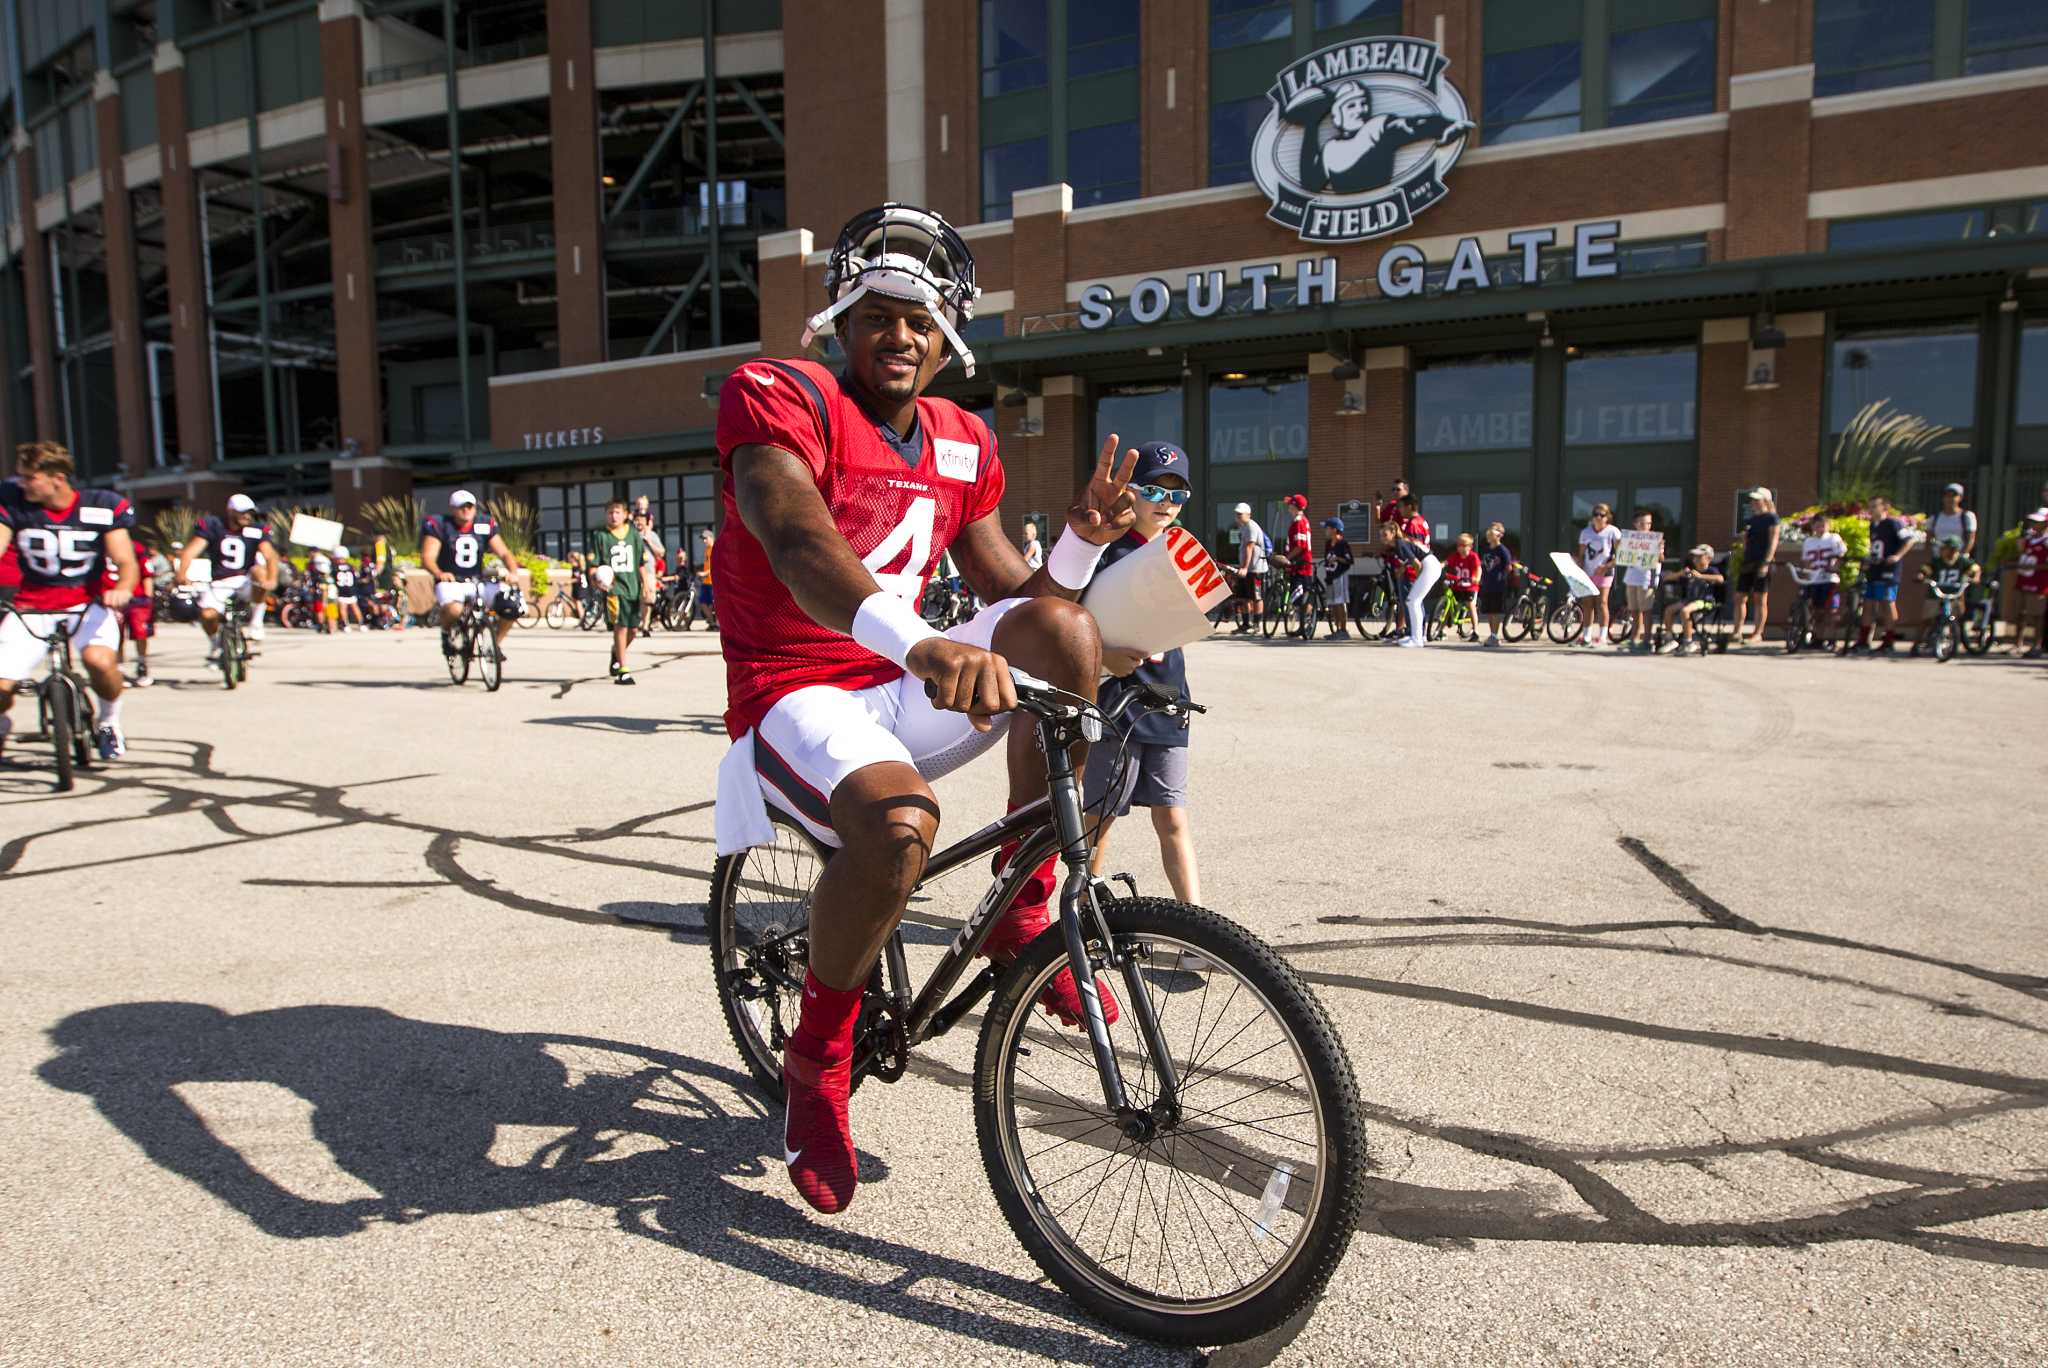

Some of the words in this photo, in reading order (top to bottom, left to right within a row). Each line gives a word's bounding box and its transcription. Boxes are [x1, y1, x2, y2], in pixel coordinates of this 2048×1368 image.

[1285, 42, 1431, 95] LAMBEAU
[1309, 200, 1399, 236] FIELD
[1079, 256, 1337, 331] SOUTH
[1376, 219, 1621, 300] GATE
[523, 426, 604, 451] TICKETS
[941, 449, 976, 473] xfinity
[887, 479, 929, 492] TEXANS
[17, 528, 99, 578] 85
[220, 537, 246, 570] 9
[455, 535, 479, 569] 8
[609, 545, 634, 573] 21
[860, 496, 936, 600] 4
[1937, 568, 1960, 588] 12
[951, 858, 1016, 957] TREK
